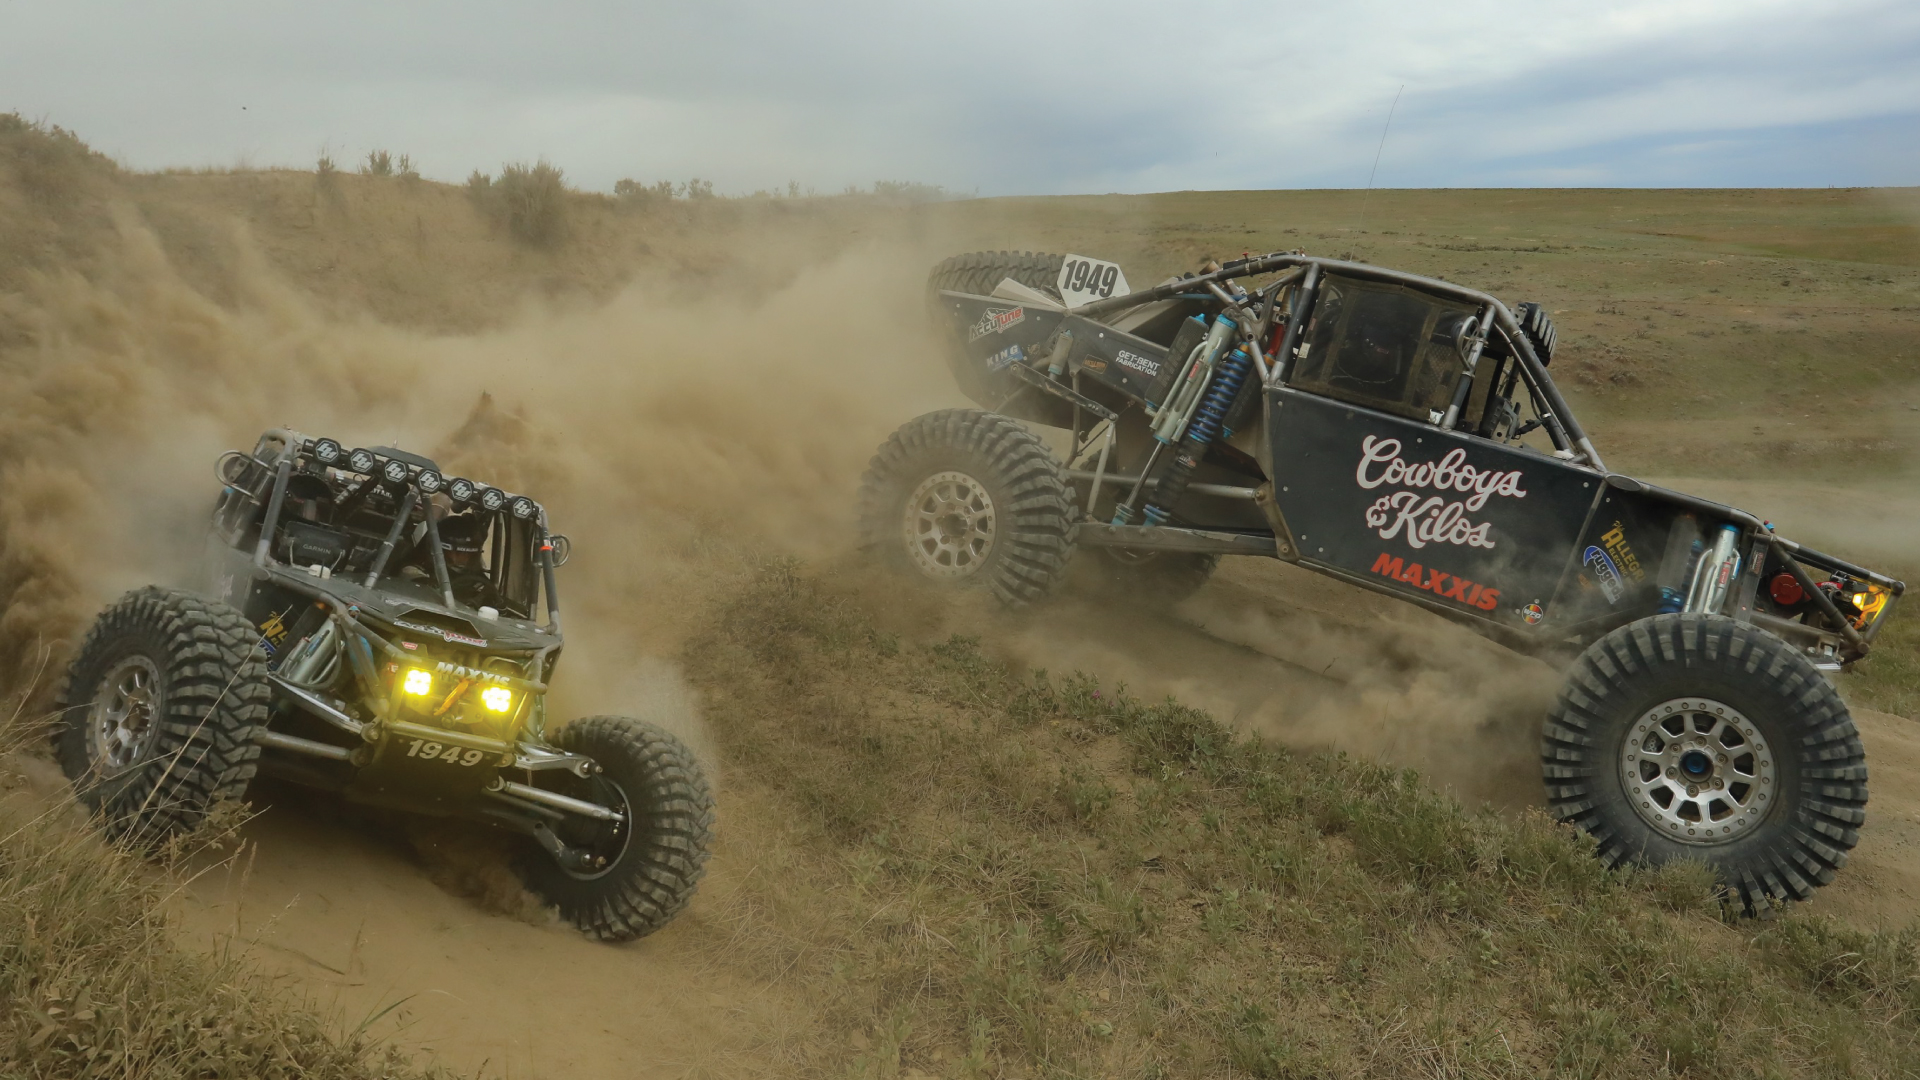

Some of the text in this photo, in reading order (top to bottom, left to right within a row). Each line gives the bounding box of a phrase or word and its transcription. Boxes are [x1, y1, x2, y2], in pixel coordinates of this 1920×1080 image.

[1063, 259, 1118, 298] 1949
[986, 344, 1018, 368] KING
[1115, 357, 1157, 377] FABRICATION
[1118, 350, 1161, 371] GET-BENT
[1356, 434, 1527, 511] Cowboys
[1365, 491, 1496, 549] & Kilos
[1609, 547, 1628, 577] ELECTRIC
[1370, 552, 1501, 611] MAXXIS
[435, 661, 511, 686] MAXXIS
[406, 739, 484, 767] 1949
